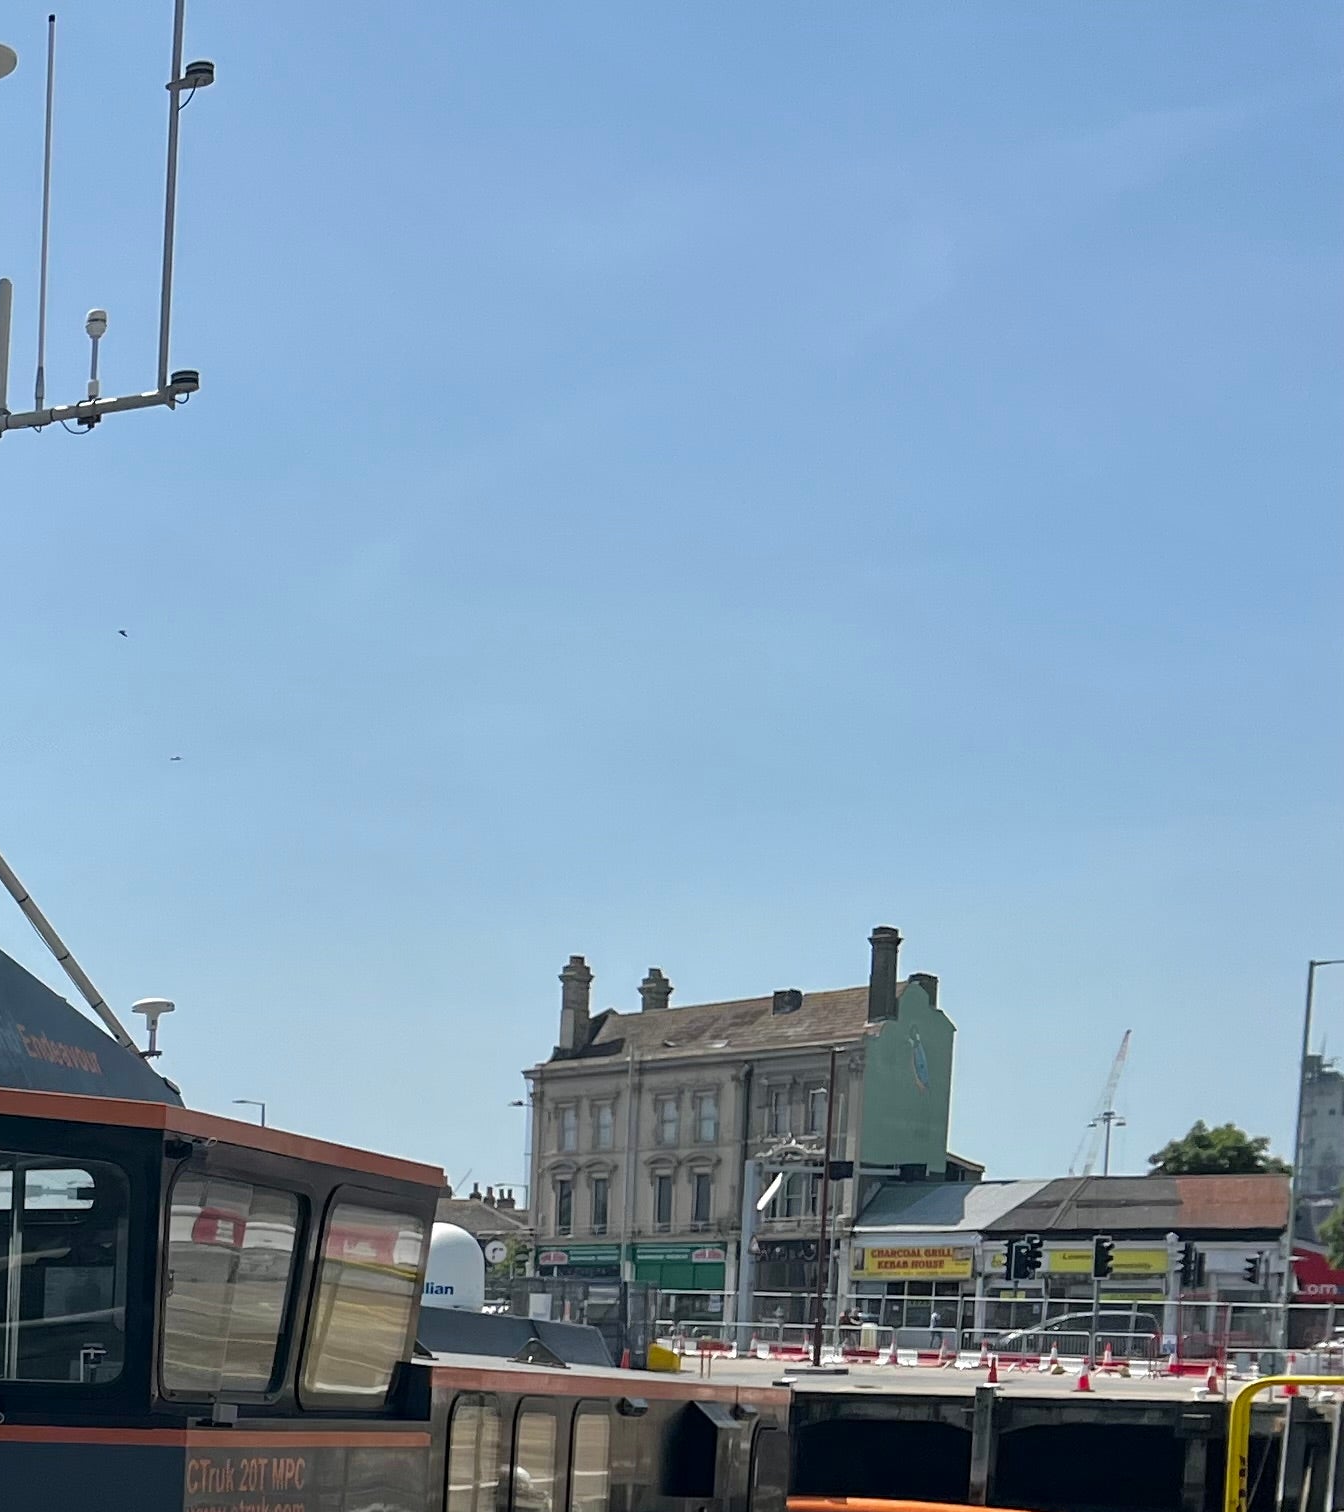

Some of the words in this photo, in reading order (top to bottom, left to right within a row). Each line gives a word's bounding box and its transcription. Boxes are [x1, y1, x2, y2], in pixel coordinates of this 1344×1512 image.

[16, 1023, 103, 1076] Endeavour
[870, 1248, 922, 1258] CHARCOAL
[924, 1248, 953, 1258] GRILL
[877, 1260, 909, 1270] KEBAB
[911, 1260, 945, 1270] HOUSE
[186, 1458, 234, 1494] CTruk
[272, 1457, 306, 1491] MPC
